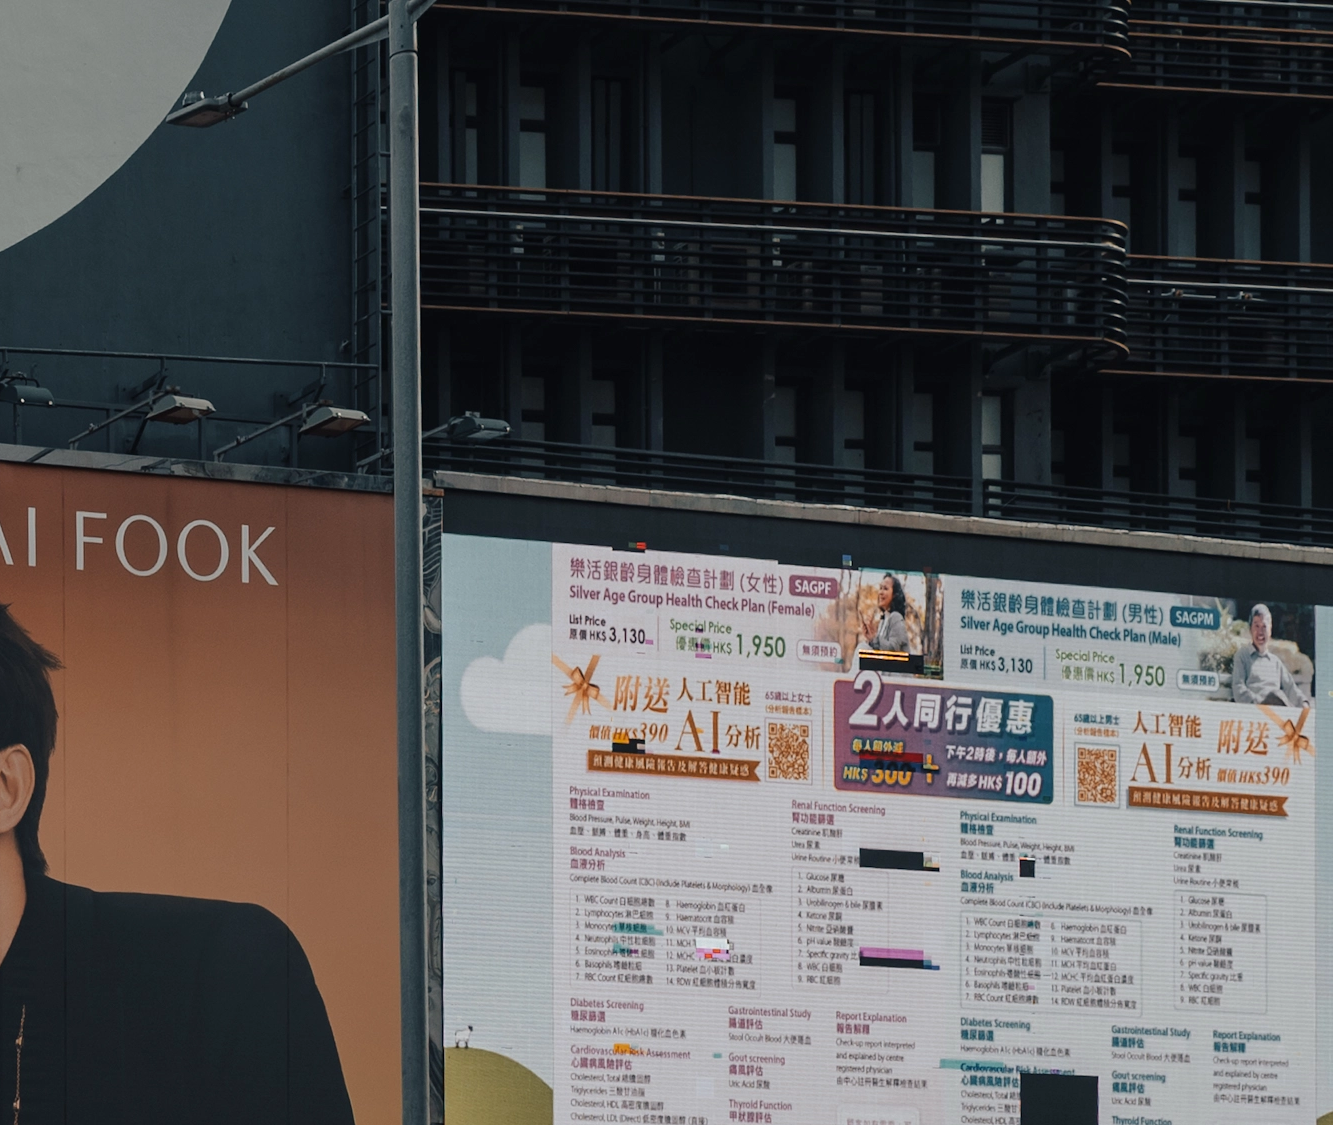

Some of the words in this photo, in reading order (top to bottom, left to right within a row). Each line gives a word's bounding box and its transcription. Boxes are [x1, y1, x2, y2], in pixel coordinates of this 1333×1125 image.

[75, 511, 279, 586] FOOK
[794, 580, 832, 596] SAGPF
[570, 585, 601, 600] Silver
[603, 588, 626, 605] Age
[628, 590, 663, 607] Group
[666, 593, 702, 608] Health
[705, 596, 739, 611] Check
[741, 598, 765, 613] Plan
[767, 600, 815, 619] (Female)
[585, 615, 606, 627] Price
[708, 621, 732, 634] Price
[1175, 610, 1214, 627] SAGPM
[609, 627, 646, 645] 3,130
[961, 616, 990, 630] Silver
[993, 619, 1014, 635] Age
[1016, 621, 1050, 639] Group
[1052, 623, 1087, 639] Health
[1089, 626, 1121, 641] Check
[1124, 628, 1146, 643] Plan
[1148, 630, 1181, 648] (Male)
[736, 634, 786, 659] 1,950
[975, 645, 995, 657] Price
[1056, 648, 1090, 662] Special
[1093, 650, 1115, 664] Price
[998, 657, 1033, 674] 3,130
[1118, 663, 1166, 687] 1,950
[613, 675, 670, 713] 附送
[677, 677, 751, 706] 人工智能
[848, 670, 1034, 734] 2人同行優惠
[1133, 711, 1202, 738] 人工智能
[1218, 719, 1270, 756] 附送
[569, 786, 601, 799] Physical
[602, 788, 651, 800] Examination
[1005, 771, 1042, 797] 100
[848, 803, 886, 816] Screening
[607, 999, 644, 1012] Screening
